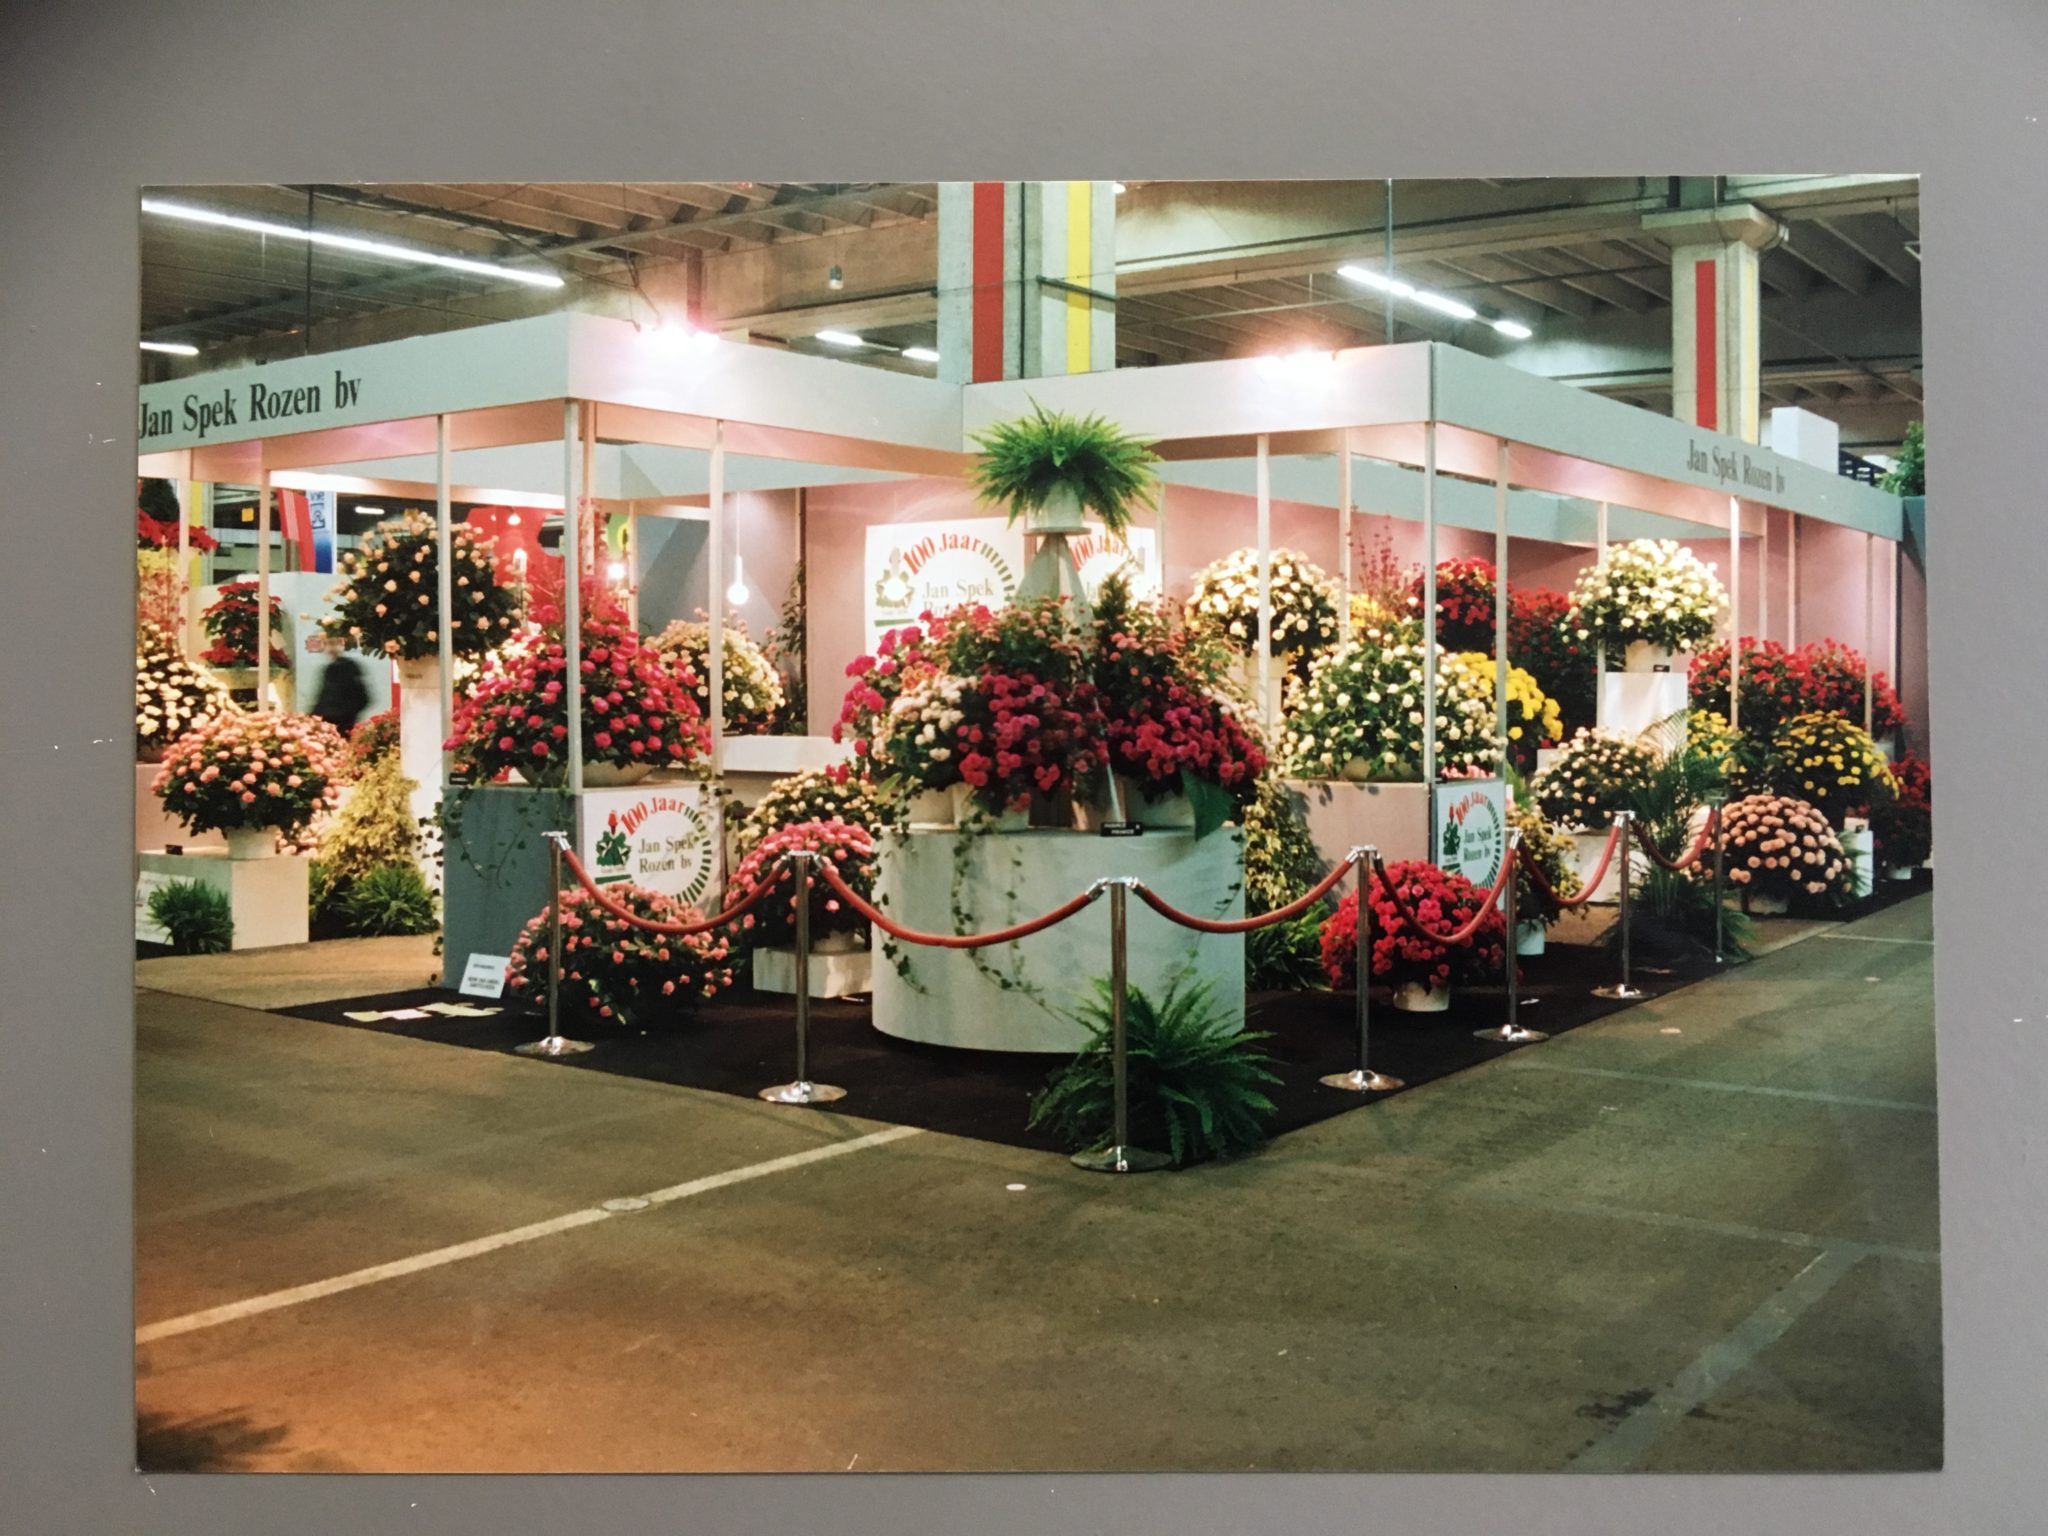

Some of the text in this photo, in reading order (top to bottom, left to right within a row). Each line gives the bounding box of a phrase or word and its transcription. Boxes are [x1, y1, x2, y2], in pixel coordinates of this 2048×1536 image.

[138, 370, 362, 439] Jan Spek Rozen bv
[1687, 438, 1708, 473] Jan
[1711, 445, 1738, 486] Spek
[1743, 454, 1772, 491] Rozen
[903, 532, 982, 575] 100 Jaar
[922, 578, 993, 600] Jan Spek
[621, 797, 685, 836] 100 Jaar
[638, 835, 695, 855] Jan Spek
[639, 858, 675, 874] Rozen
[681, 855, 692, 869] bv
